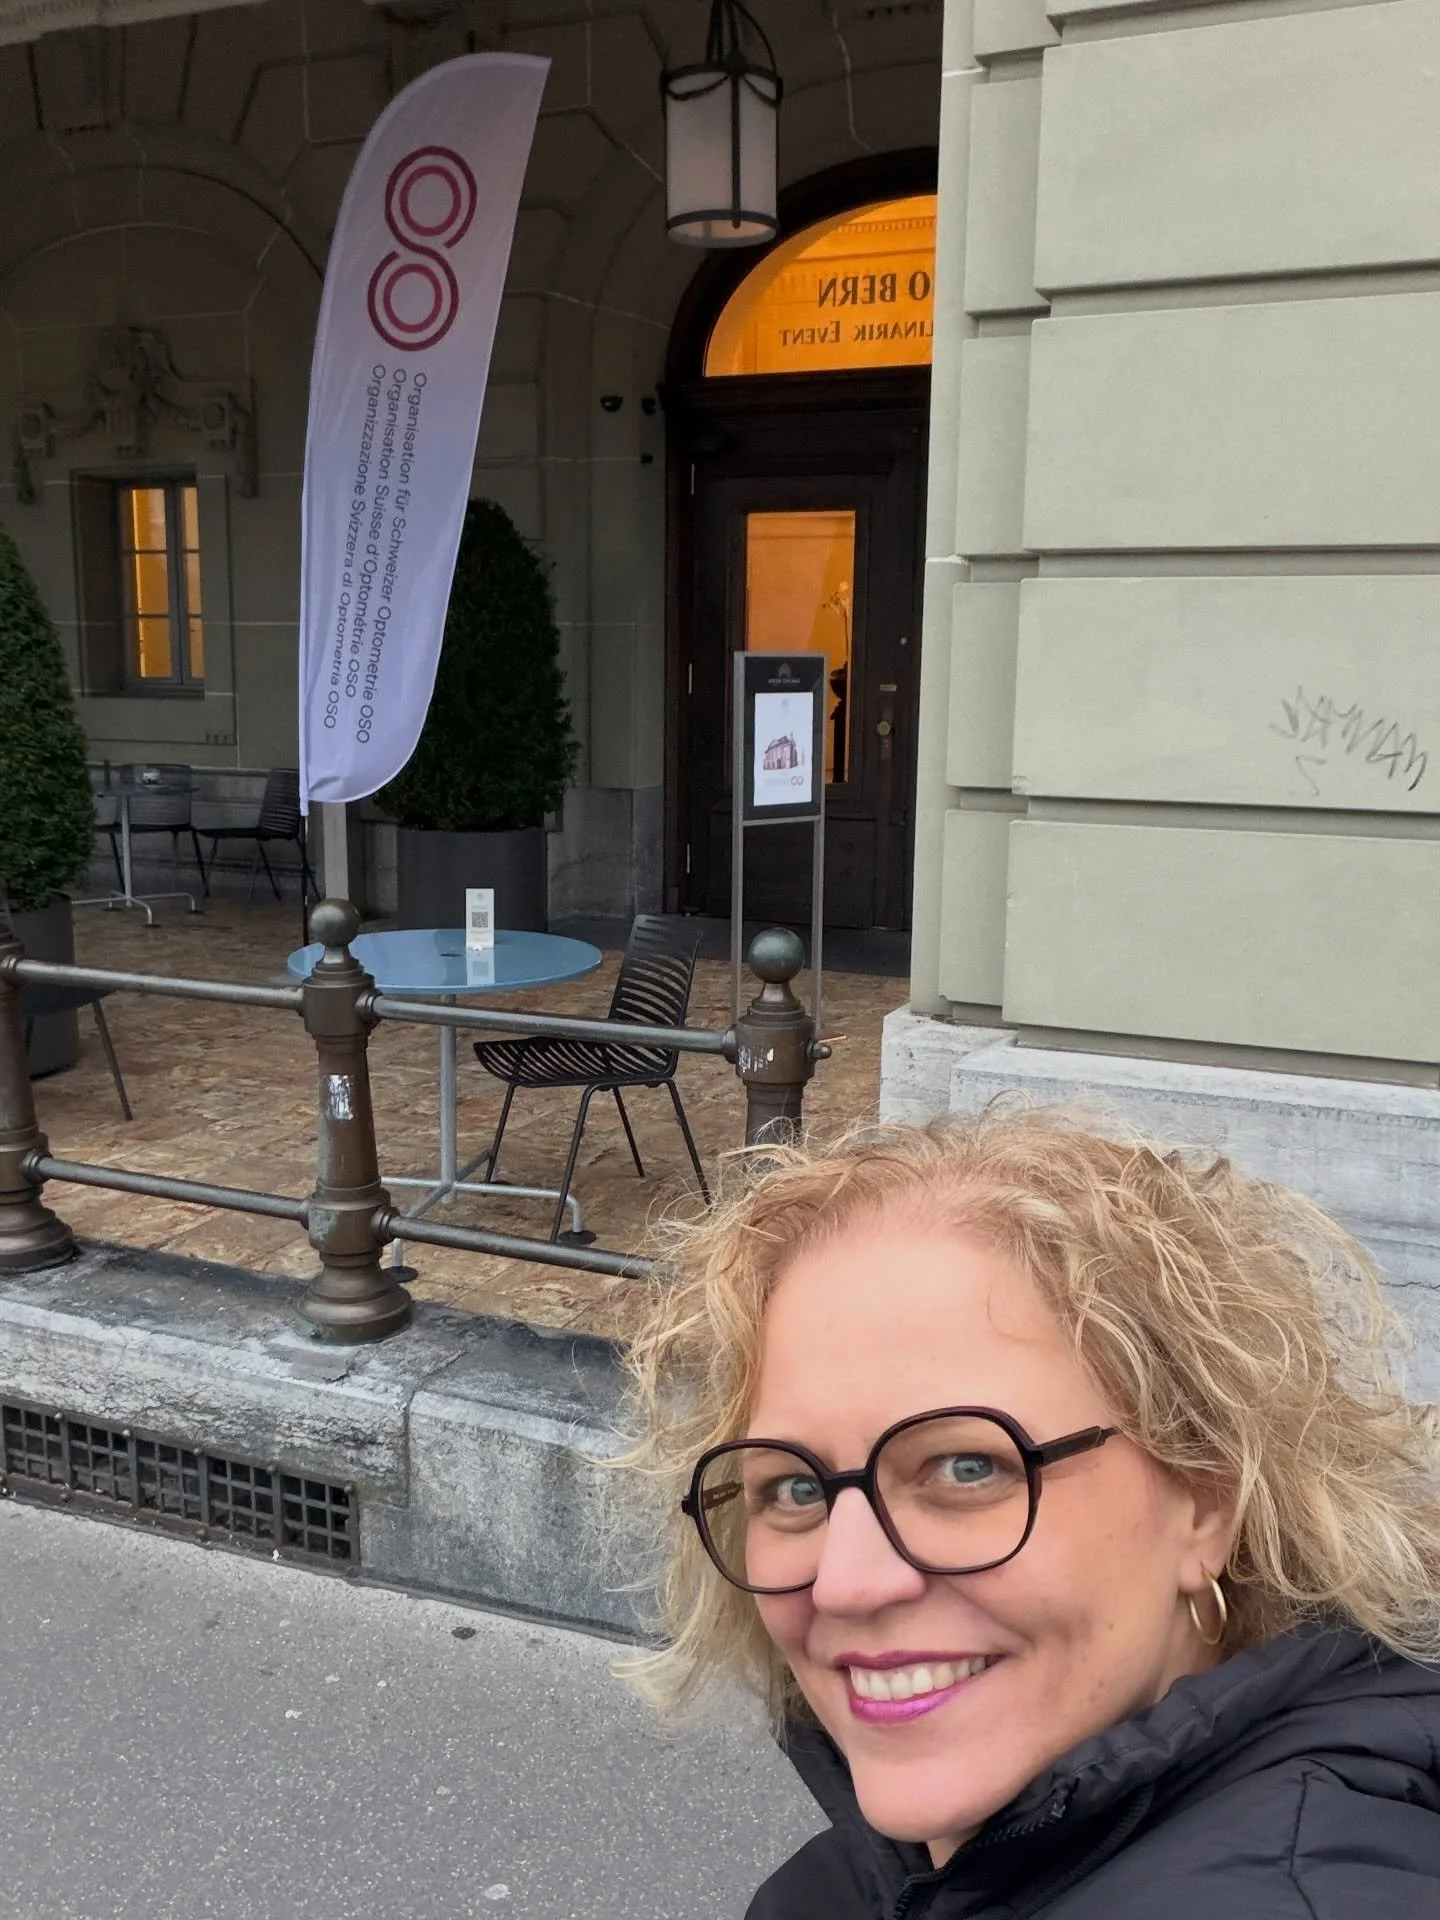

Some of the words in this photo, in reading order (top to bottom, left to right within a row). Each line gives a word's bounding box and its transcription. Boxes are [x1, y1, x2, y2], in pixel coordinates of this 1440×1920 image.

[354, 364, 386, 495] Organizzazione
[378, 368, 407, 479] Organisation
[398, 372, 427, 484] Organisation
[344, 499, 365, 567] Svizzera
[369, 485, 389, 540] Suisse
[395, 489, 411, 513] für
[342, 572, 352, 588] di
[382, 516, 406, 602] Schweizer
[331, 592, 351, 686] Optometria
[363, 606, 391, 700] Optometrie
[324, 691, 339, 728] OSO
[346, 659, 360, 697] OSO
[357, 705, 373, 743] OSO
